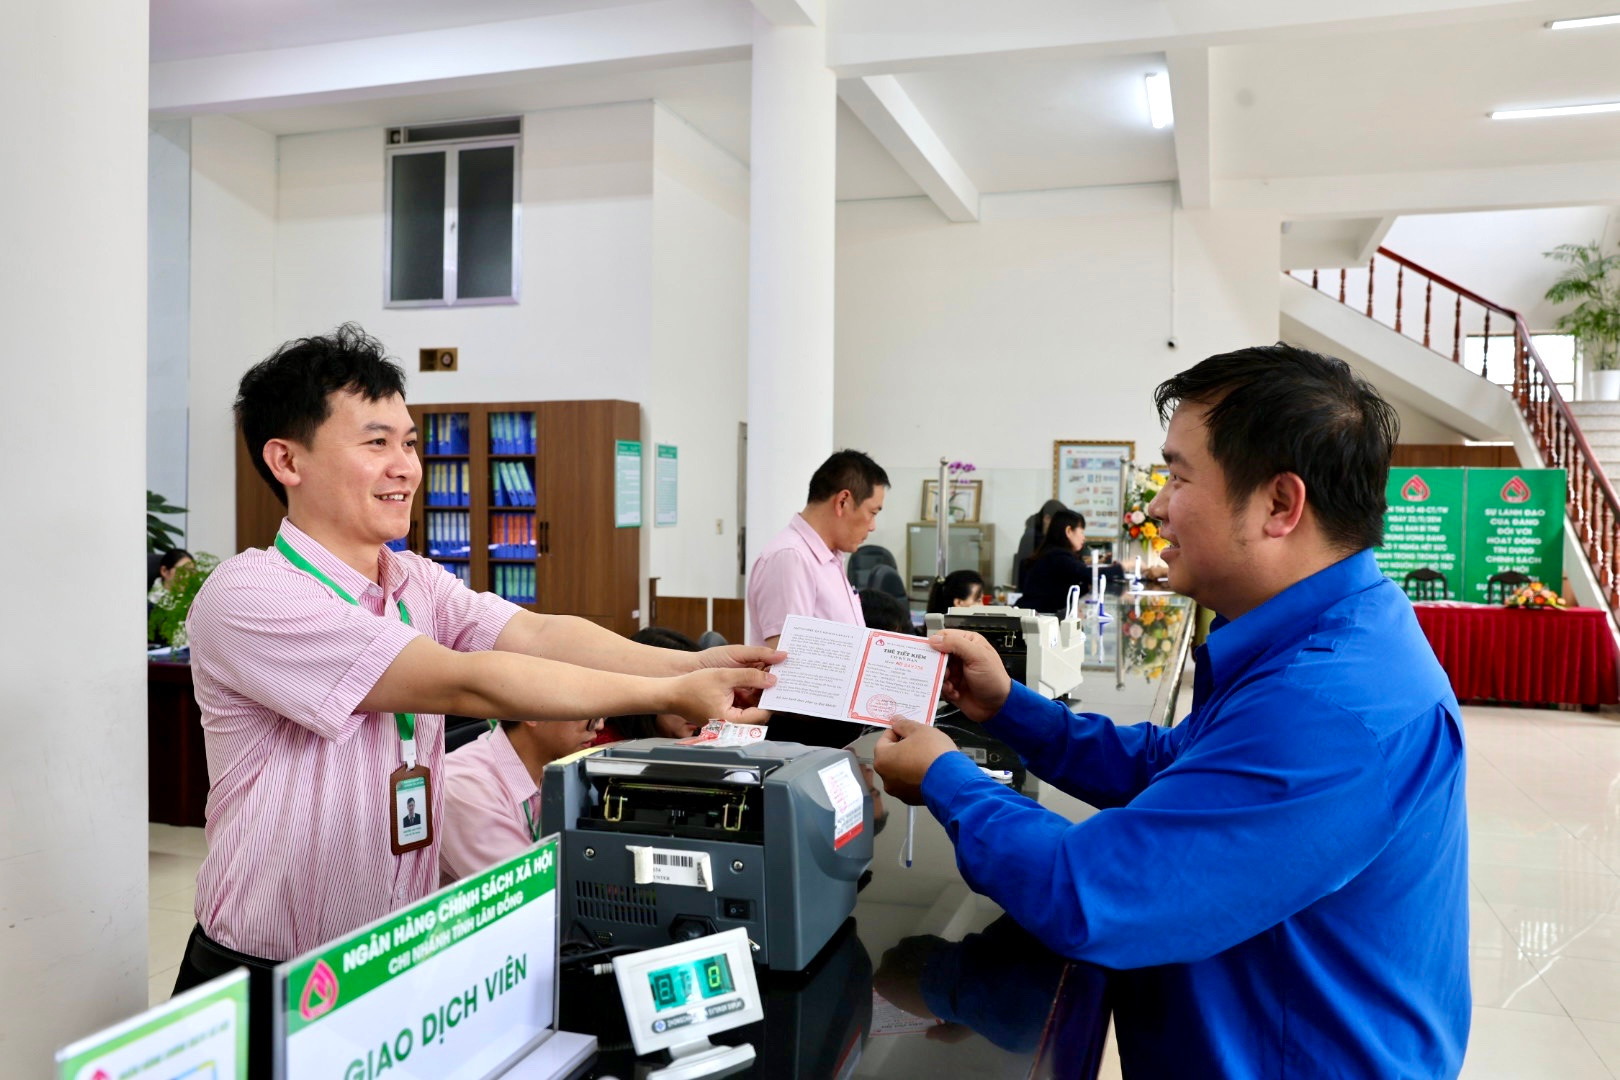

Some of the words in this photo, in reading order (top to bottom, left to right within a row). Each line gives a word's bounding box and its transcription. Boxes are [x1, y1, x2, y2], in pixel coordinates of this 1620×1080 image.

[343, 932, 391, 974] NGÂN
[393, 910, 436, 947] HÀNG
[438, 887, 480, 922] CHÍNH
[481, 870, 514, 901] SÁCH
[516, 858, 532, 884] XÃ
[534, 849, 552, 874] HỘI
[388, 950, 410, 974] CHI
[412, 930, 450, 963] NHÁNH
[452, 916, 474, 940] TỈNH
[476, 906, 496, 928] LÂM
[496, 890, 524, 916] ĐỒNG
[344, 1028, 413, 1080] GIAO
[422, 984, 477, 1046] DỊCH
[485, 953, 526, 1002] VIÊN
